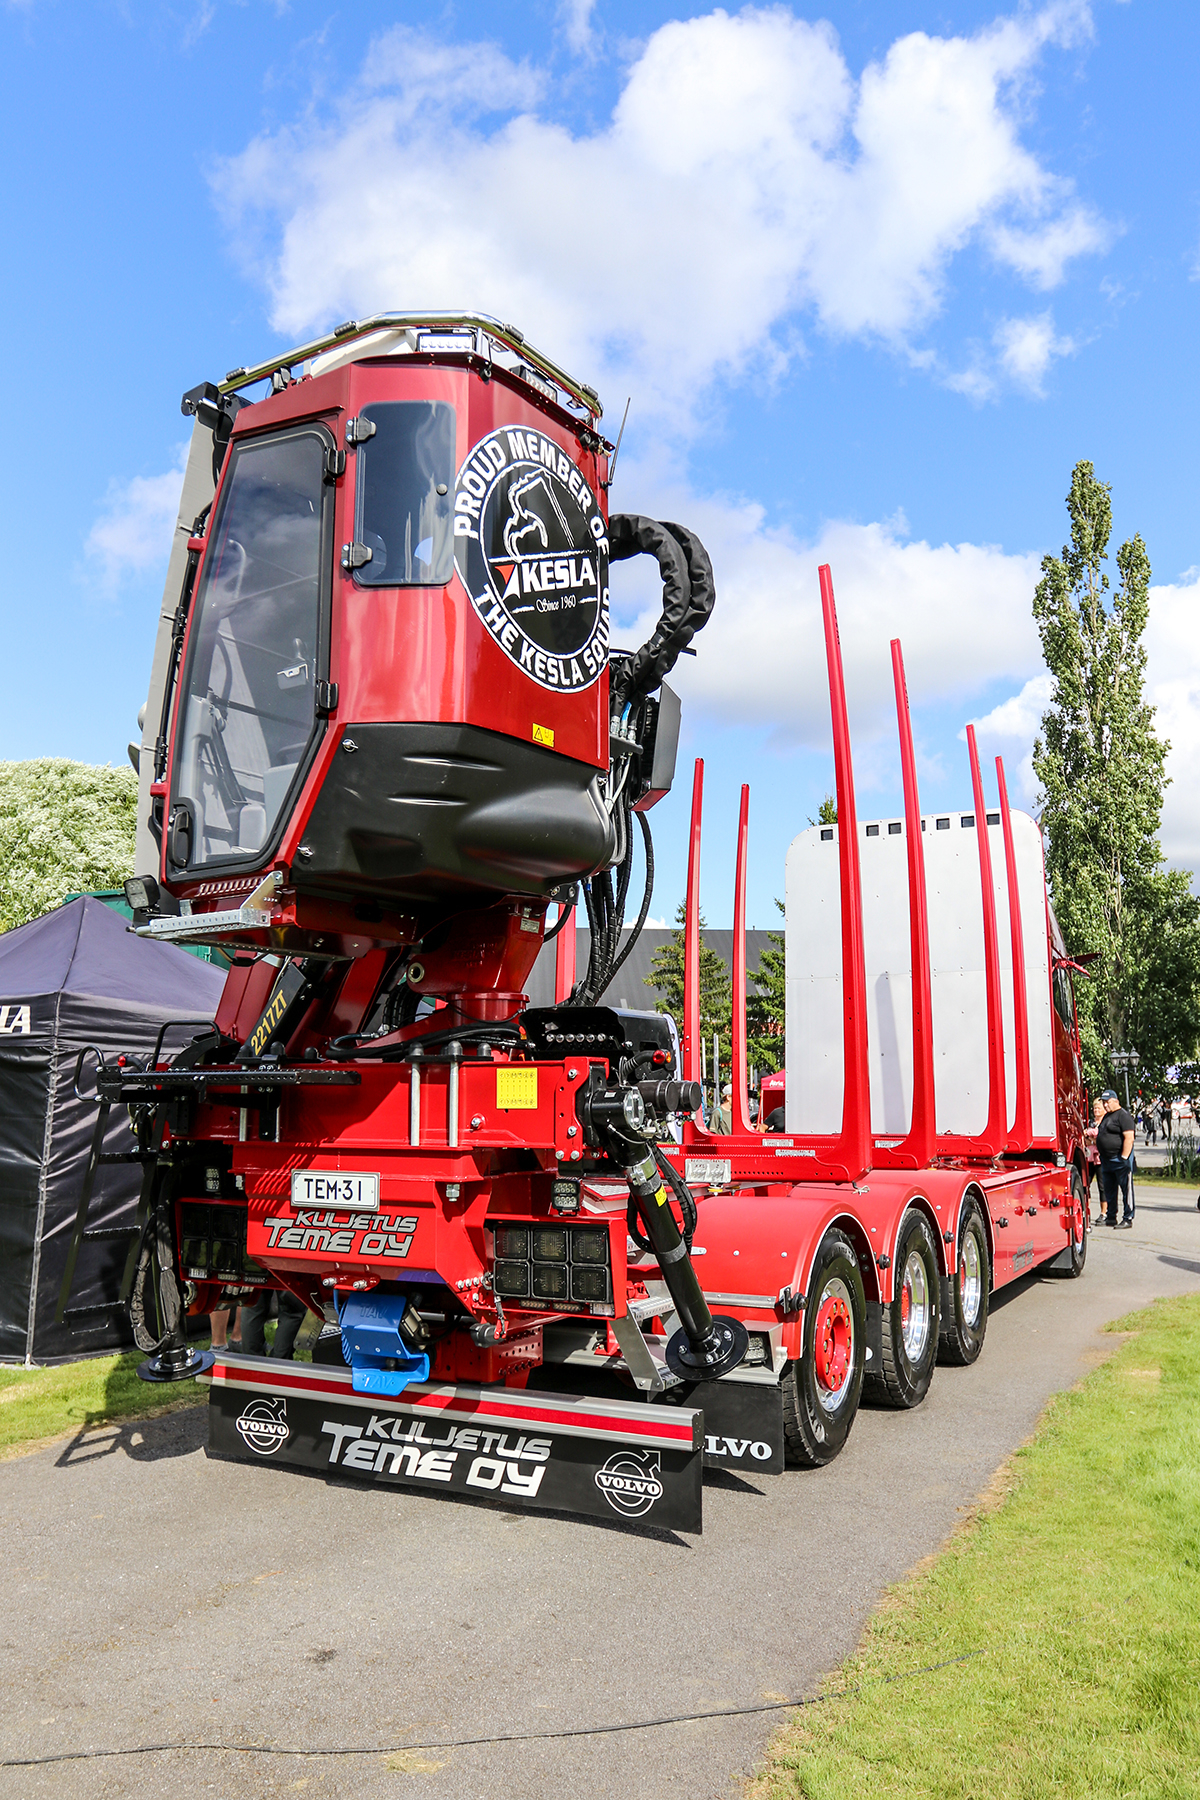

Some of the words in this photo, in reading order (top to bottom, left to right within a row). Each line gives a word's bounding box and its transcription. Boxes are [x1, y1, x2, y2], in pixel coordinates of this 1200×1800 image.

[453, 439, 507, 540] PROUD
[506, 431, 593, 514] MEMBER
[590, 515, 609, 556] OF
[522, 557, 596, 594] KESLA
[536, 598, 559, 612] Since
[561, 594, 576, 609] 1960
[475, 583, 519, 652] THE
[519, 645, 584, 686] KESLA
[0, 1005, 30, 1034] LA
[250, 989, 287, 1056] 2217ZT
[304, 1178, 362, 1201] TEM-31
[263, 1217, 356, 1253] TEME
[358, 1232, 414, 1258] OY
[294, 1210, 419, 1233] KULJETUS
[239, 1420, 287, 1436] VOLVO
[365, 1415, 553, 1462] KULJETUS
[321, 1420, 458, 1482] TEME
[465, 1456, 547, 1498] OY
[704, 1435, 773, 1461] LVO
[598, 1474, 660, 1495] VOLVO
